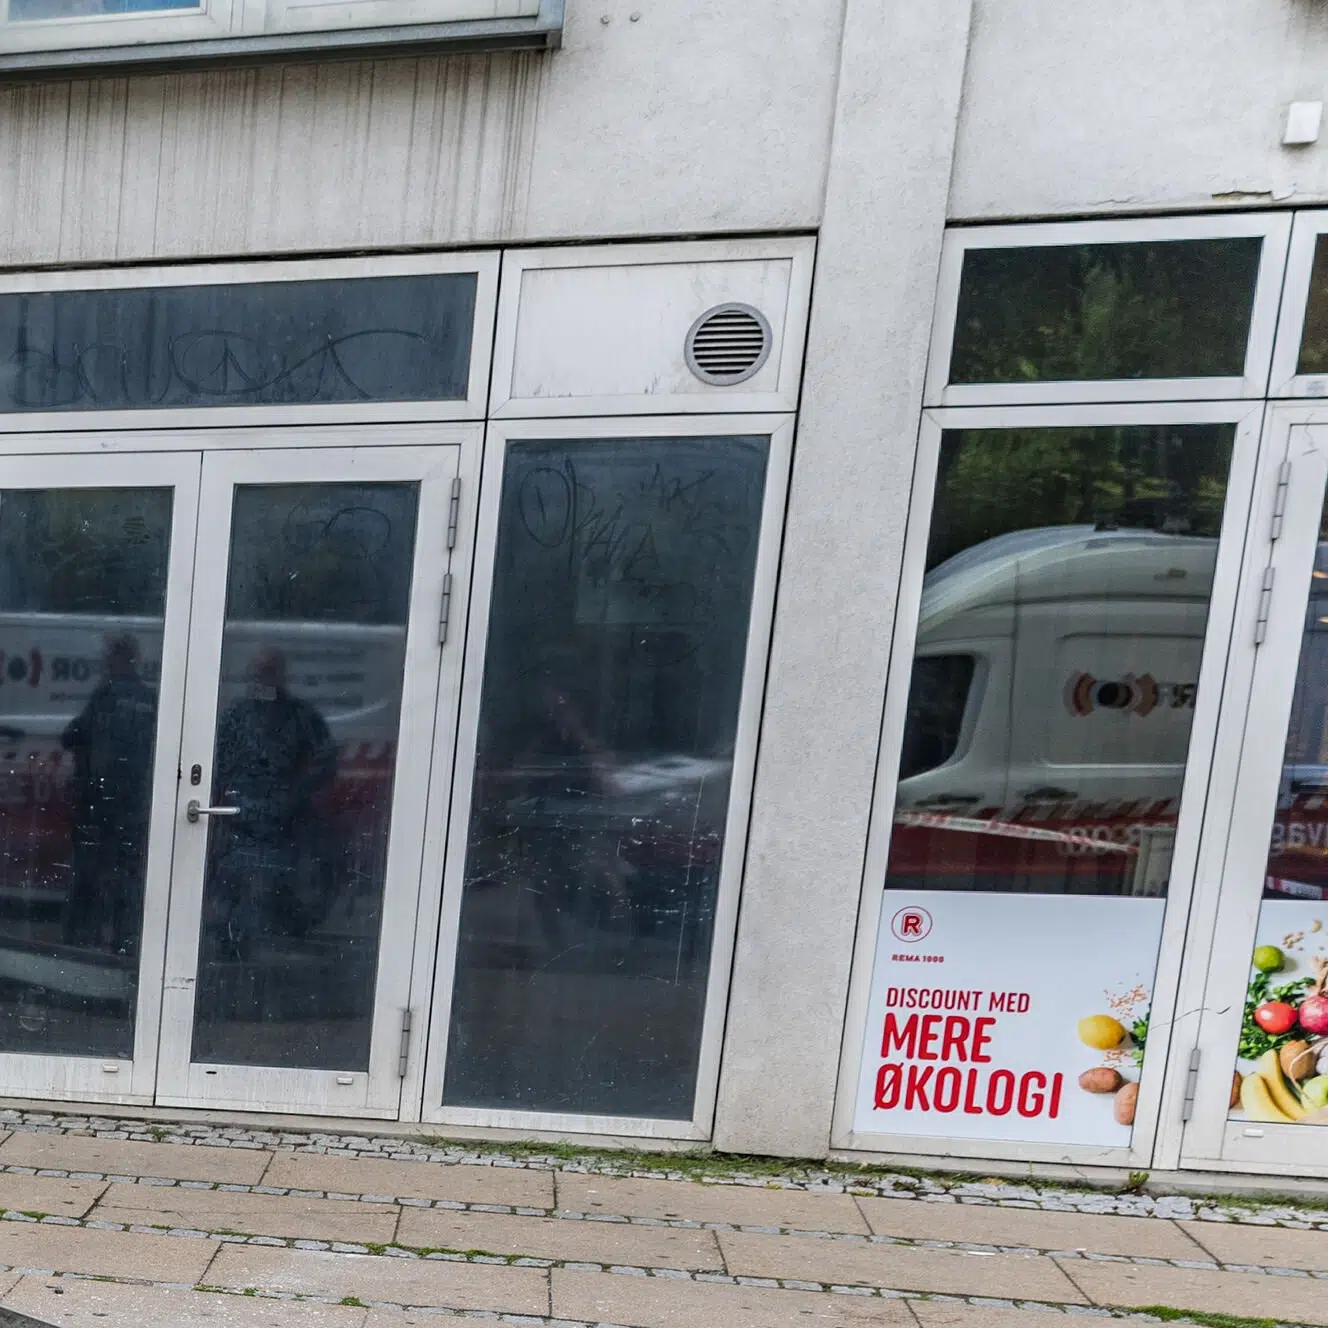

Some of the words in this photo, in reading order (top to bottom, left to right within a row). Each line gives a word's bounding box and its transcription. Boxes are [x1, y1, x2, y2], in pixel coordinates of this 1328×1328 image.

[901, 912, 923, 937] R
[891, 954, 921, 963] REMA
[922, 955, 945, 964] 1000
[885, 987, 983, 1012] DISCOUNT
[988, 991, 1031, 1014] MED
[880, 1011, 997, 1064] MERE
[873, 1062, 1064, 1120] ØKOLOGI
